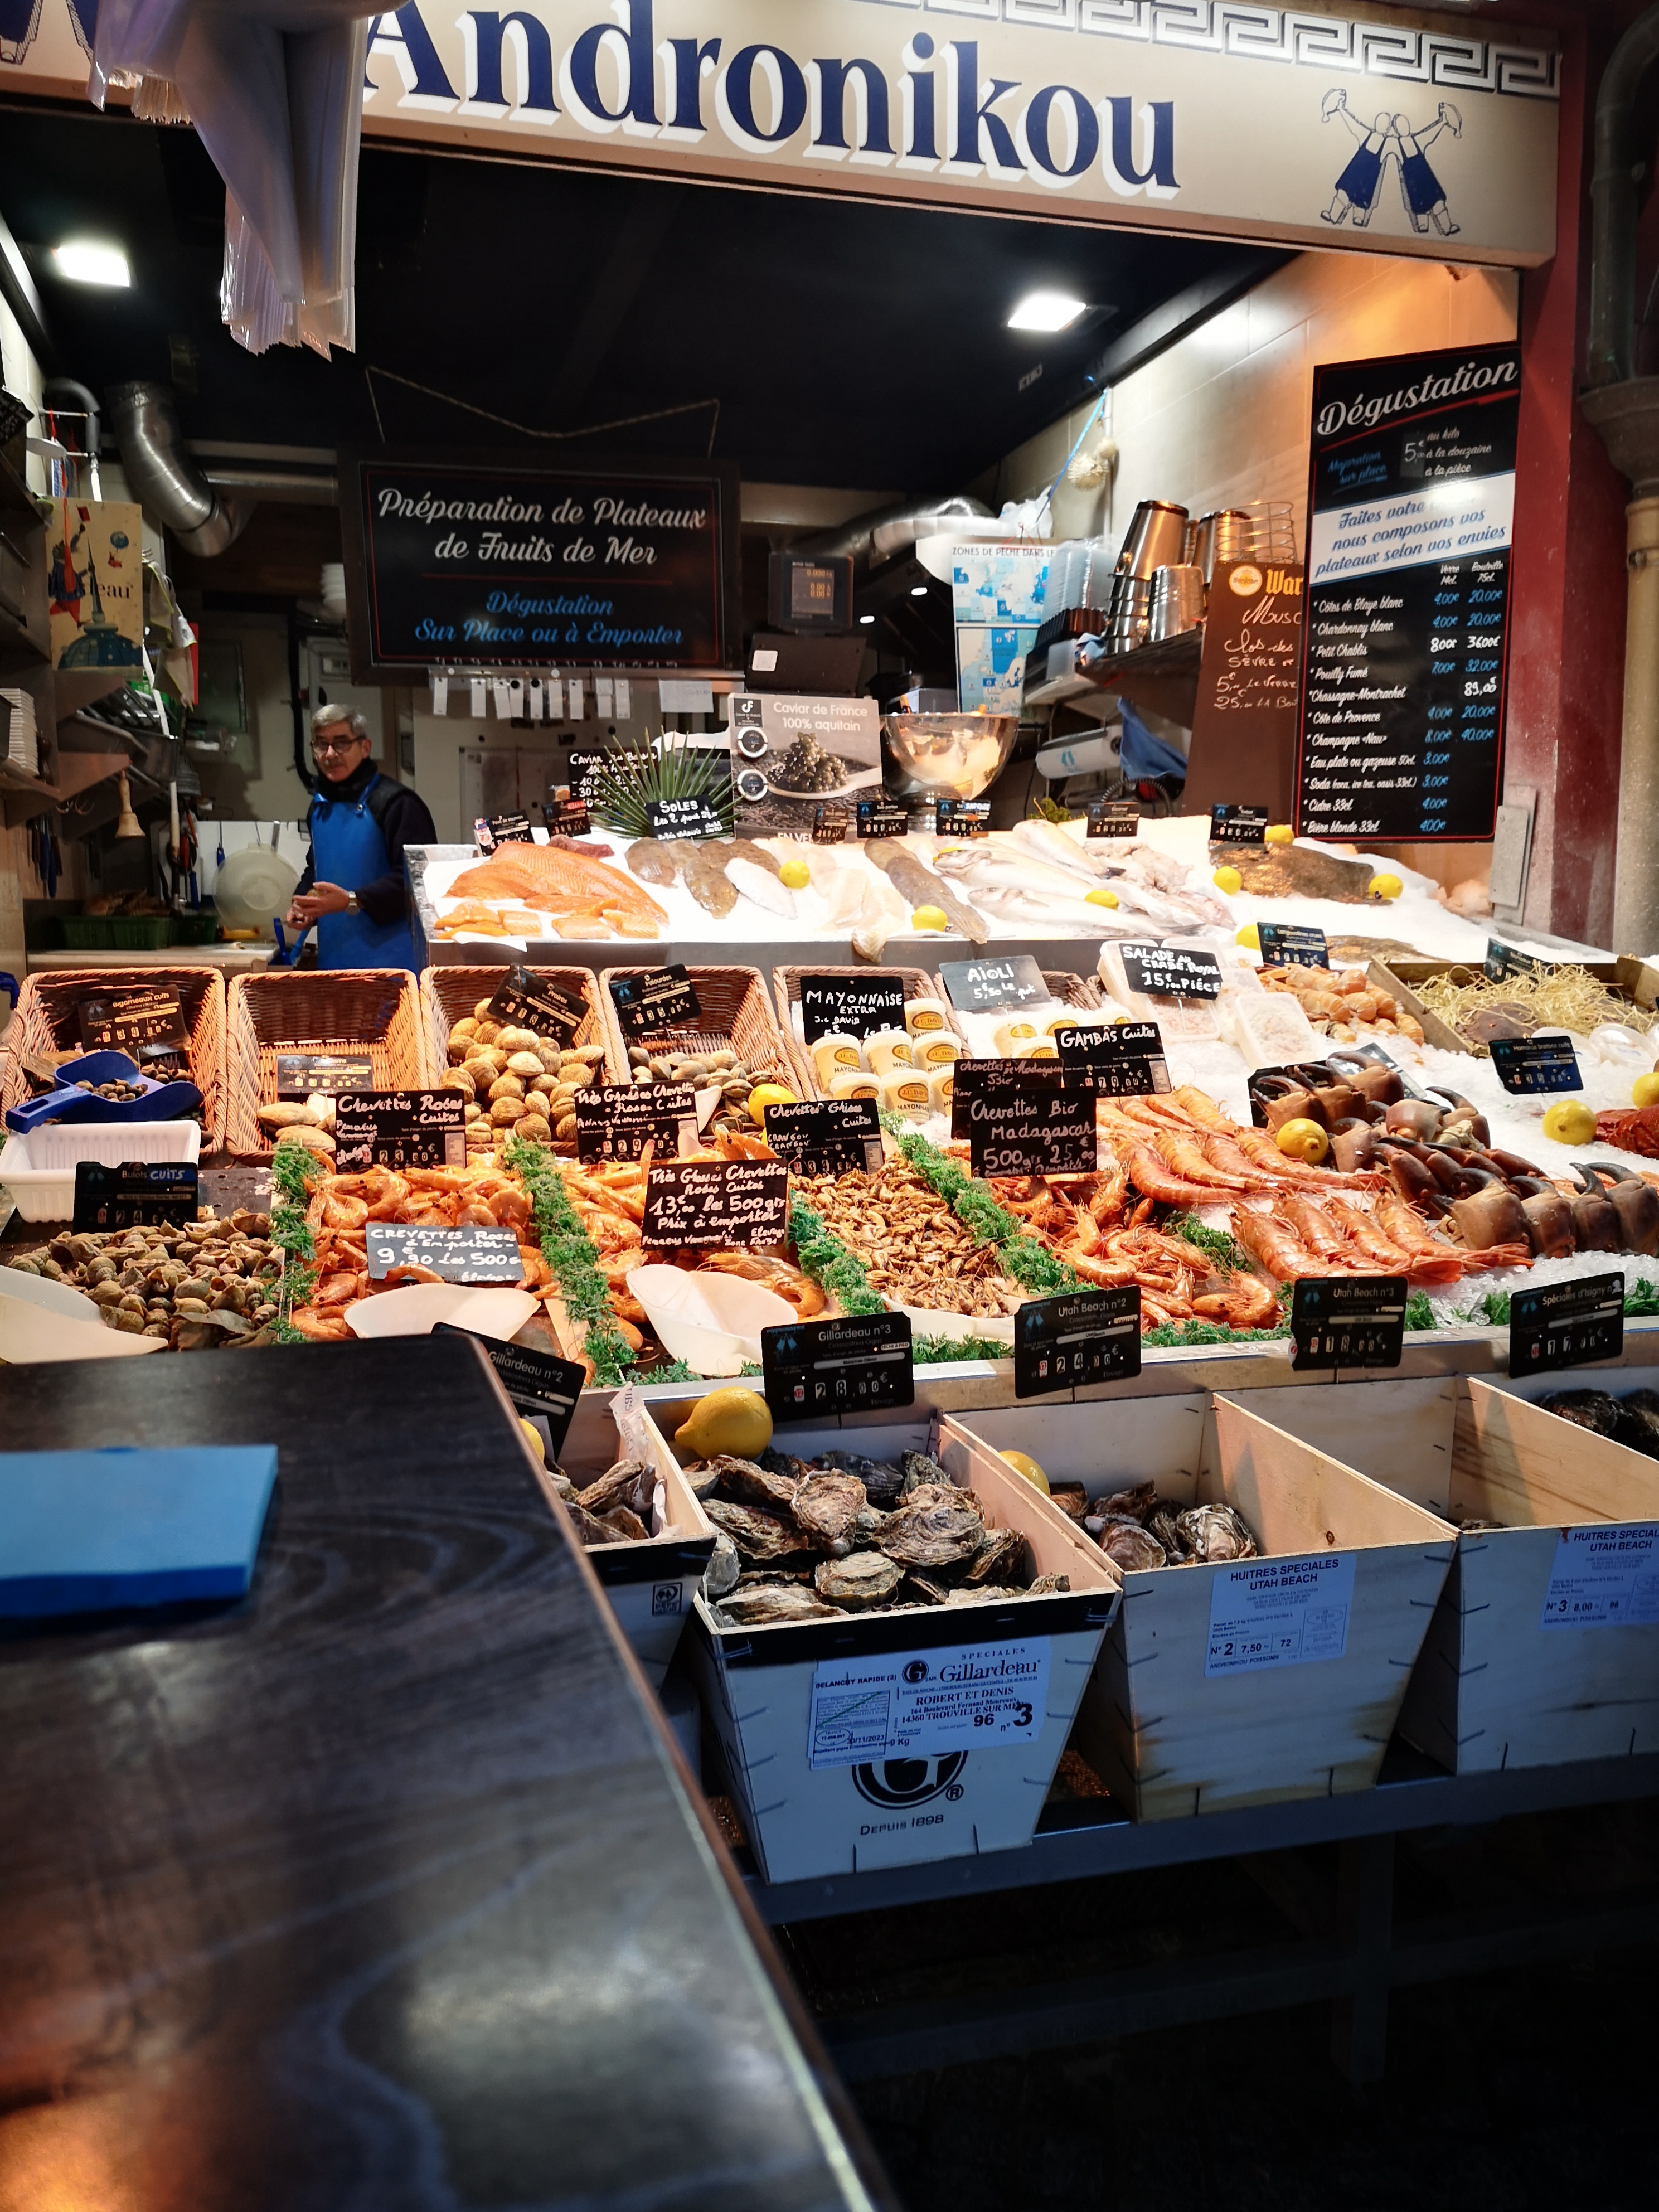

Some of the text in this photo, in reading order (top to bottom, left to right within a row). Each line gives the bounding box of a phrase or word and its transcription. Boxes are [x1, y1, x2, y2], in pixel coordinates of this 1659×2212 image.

[361, 0, 1181, 190] Andronikou
[1317, 361, 1517, 435] Dégustation
[1448, 444, 1492, 459] douzaine
[1445, 464, 1471, 476] pièce
[378, 488, 707, 528] Préparation de Plateaux
[1338, 508, 1381, 529] Faites
[1386, 501, 1424, 520] votre
[1331, 510, 1485, 552] nous composons vos
[435, 532, 657, 565] de Fruits de Mer
[953, 547, 979, 556] ZONES
[1315, 525, 1506, 579] plateaux selon vos envies
[486, 591, 613, 617] Dégustation
[1318, 600, 1340, 613] Côtes
[1342, 599, 1352, 612] de
[1379, 596, 1403, 608] blanc
[414, 618, 684, 648] Sur Place ou à Emporter
[1318, 621, 1368, 639] Chardonnay
[1370, 619, 1393, 632] blanc
[1316, 643, 1367, 657] Petit Chablis
[1315, 667, 1344, 685] Pouilly
[1346, 665, 1367, 678] Fumé
[774, 702, 867, 717] Caviar de France
[1313, 711, 1331, 724] Côte
[1332, 711, 1342, 724] de
[1343, 710, 1380, 723] Provence
[782, 717, 860, 732] 100% aquitain
[1312, 733, 1360, 751] Champagne
[1310, 755, 1326, 768] Eau
[1326, 755, 1348, 770] plate
[1350, 758, 1361, 766] ou
[1361, 757, 1396, 773] gazeuse
[1309, 777, 1330, 790] Soda
[1308, 798, 1331, 812] Cidre
[1330, 820, 1357, 833] blonde
[1122, 946, 1175, 962] SALADE
[1060, 1030, 1117, 1049] GAMBAS
[1049, 1100, 1078, 1118] Bio
[991, 1121, 1095, 1146] Madagascar
[122, 1170, 147, 1180] Bulots
[649, 1168, 676, 1184] Très
[370, 1229, 463, 1240] CREVETTES
[1333, 1287, 1394, 1297] Utah Beach n°3
[1543, 1292, 1576, 1306] Spéciales
[1059, 1298, 1126, 1317] Utah Beach n°2
[818, 1324, 891, 1341] Gillardeau n°3
[488, 1351, 542, 1376] Gillardeau
[544, 1370, 564, 1383] n°2
[1574, 1532, 1616, 1541] HUITRES
[1590, 1541, 1652, 1551] UTAH BEACH
[1231, 1559, 1339, 1582] HUITRES SPECIALES
[1250, 1573, 1318, 1590] UTAH BEACH
[1559, 1600, 1568, 1612] 3
[962, 1647, 1025, 1660] SPECIALES
[1211, 1639, 1291, 1656] N° 2 7,50 72
[940, 1659, 1037, 1682] Gillardeau
[1210, 1659, 1248, 1669] ANDRONIKOU
[858, 1675, 885, 1684] RAPIDE
[916, 1687, 1014, 1706] ROBERT ET DENIS
[958, 1701, 984, 1709] Fernand
[926, 1709, 982, 1720] TROUVILLE
[983, 1705, 1001, 1714] SUR
[973, 1713, 995, 1727] 96
[1013, 1703, 1033, 1726] 3
[860, 1814, 944, 1835] DEPUIS 1898
